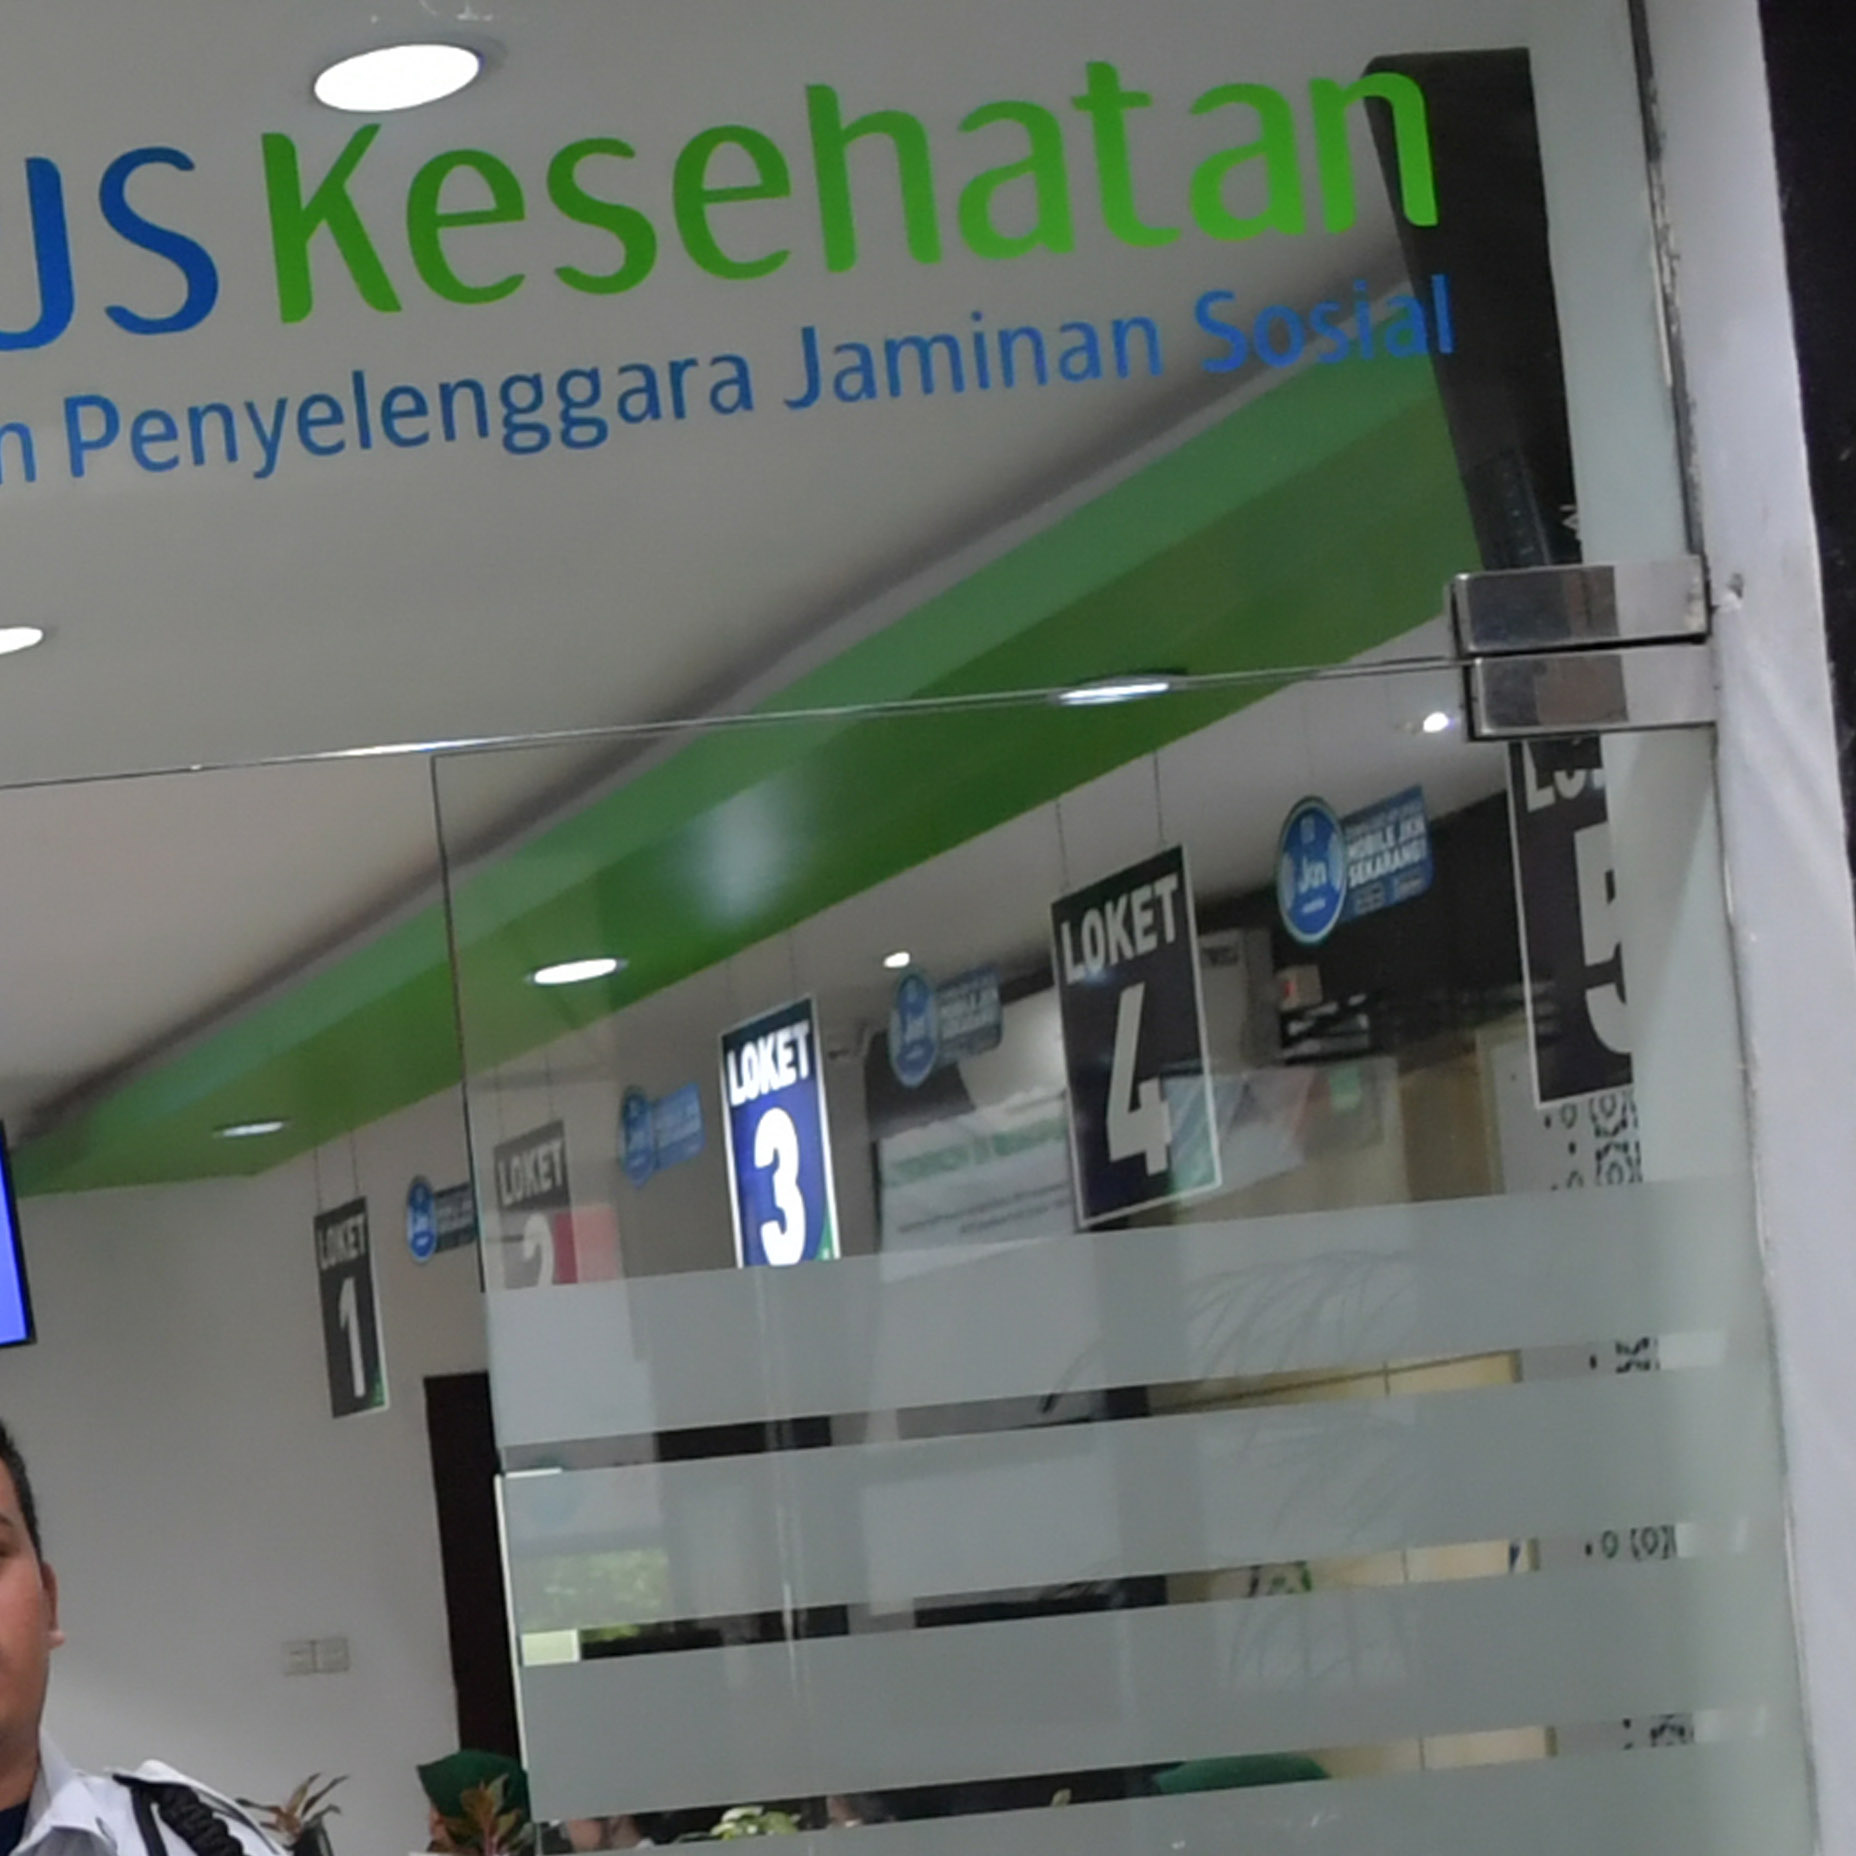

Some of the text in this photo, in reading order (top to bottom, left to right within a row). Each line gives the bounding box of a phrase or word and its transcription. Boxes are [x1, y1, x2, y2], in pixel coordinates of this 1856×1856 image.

[261, 60, 1440, 325] Kesehatan
[63, 350, 755, 479] Penyelenggara
[782, 310, 1164, 410] Jaminan
[1192, 273, 1456, 374] Sosial
[1060, 872, 1179, 985] LOKET
[727, 1019, 810, 1107] LOKET
[1106, 982, 1172, 1177] 4
[498, 1138, 563, 1207] LOKET
[753, 1106, 806, 1267] 3
[317, 1212, 367, 1272] LOKET
[338, 1276, 366, 1398] 1
